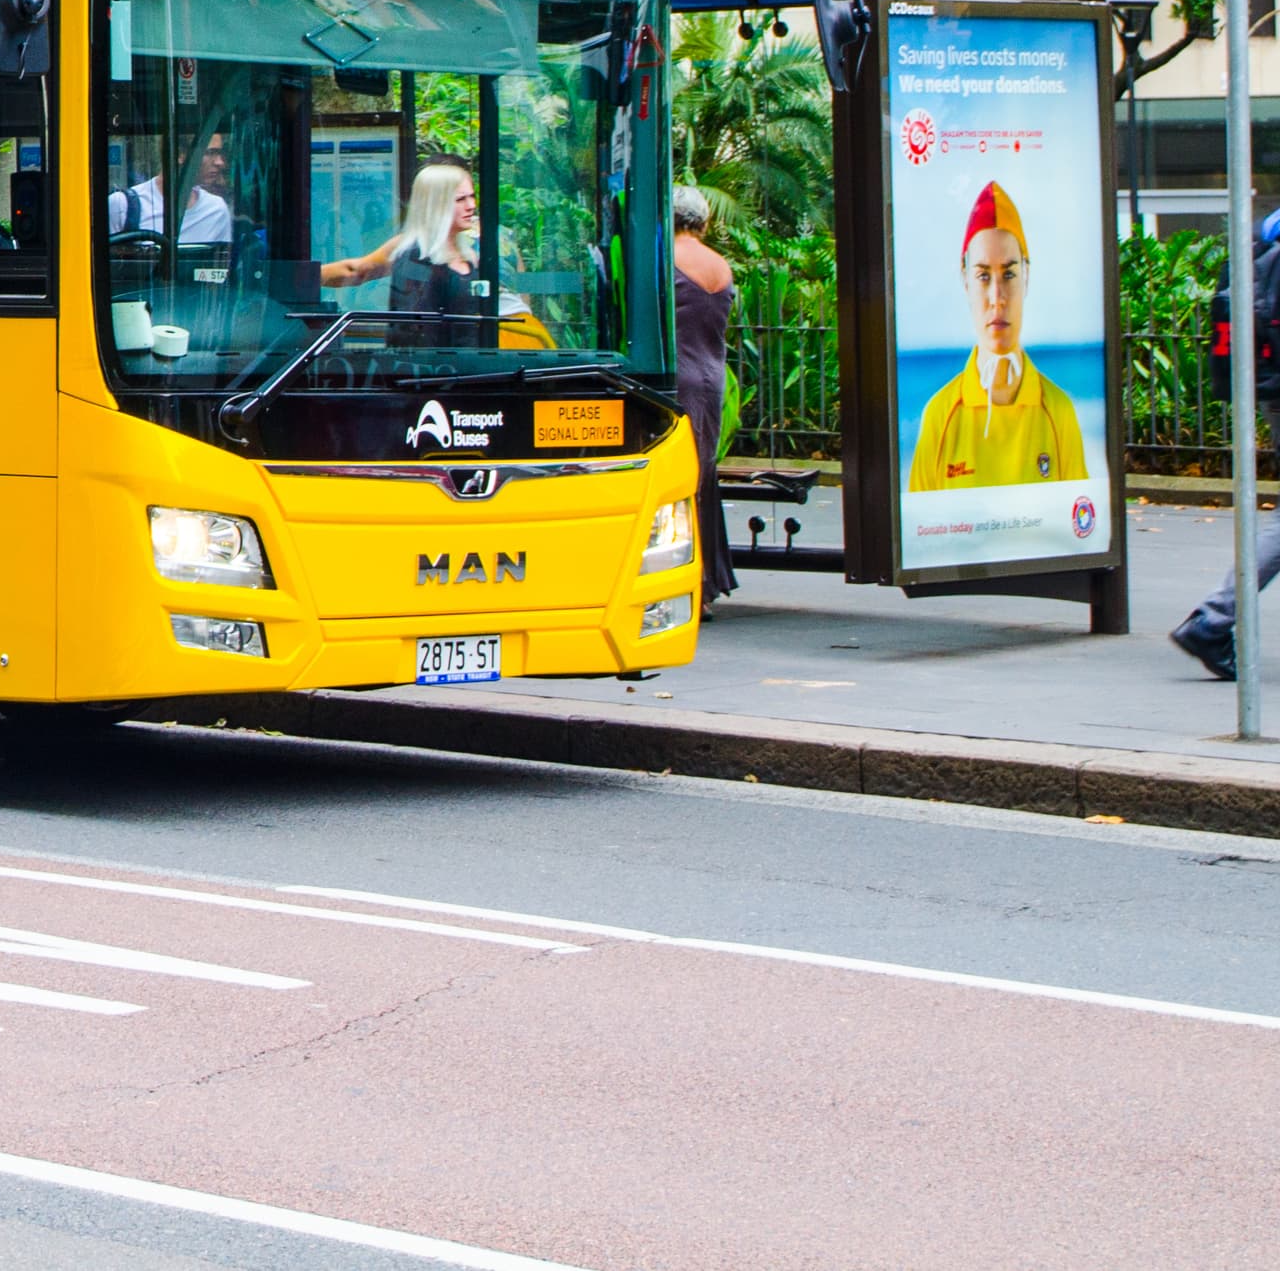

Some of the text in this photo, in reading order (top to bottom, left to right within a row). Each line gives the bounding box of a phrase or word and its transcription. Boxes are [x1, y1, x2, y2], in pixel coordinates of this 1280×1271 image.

[888, 2, 935, 16] JCDecaux
[898, 44, 1067, 70] Saving lives costs money.
[898, 74, 1067, 97] We need your donations.
[450, 410, 504, 429] Transport
[558, 406, 601, 421] PLEASE
[453, 430, 489, 447] Buses
[538, 426, 620, 441] SIGNAL DRIVER
[416, 550, 527, 586] MAN
